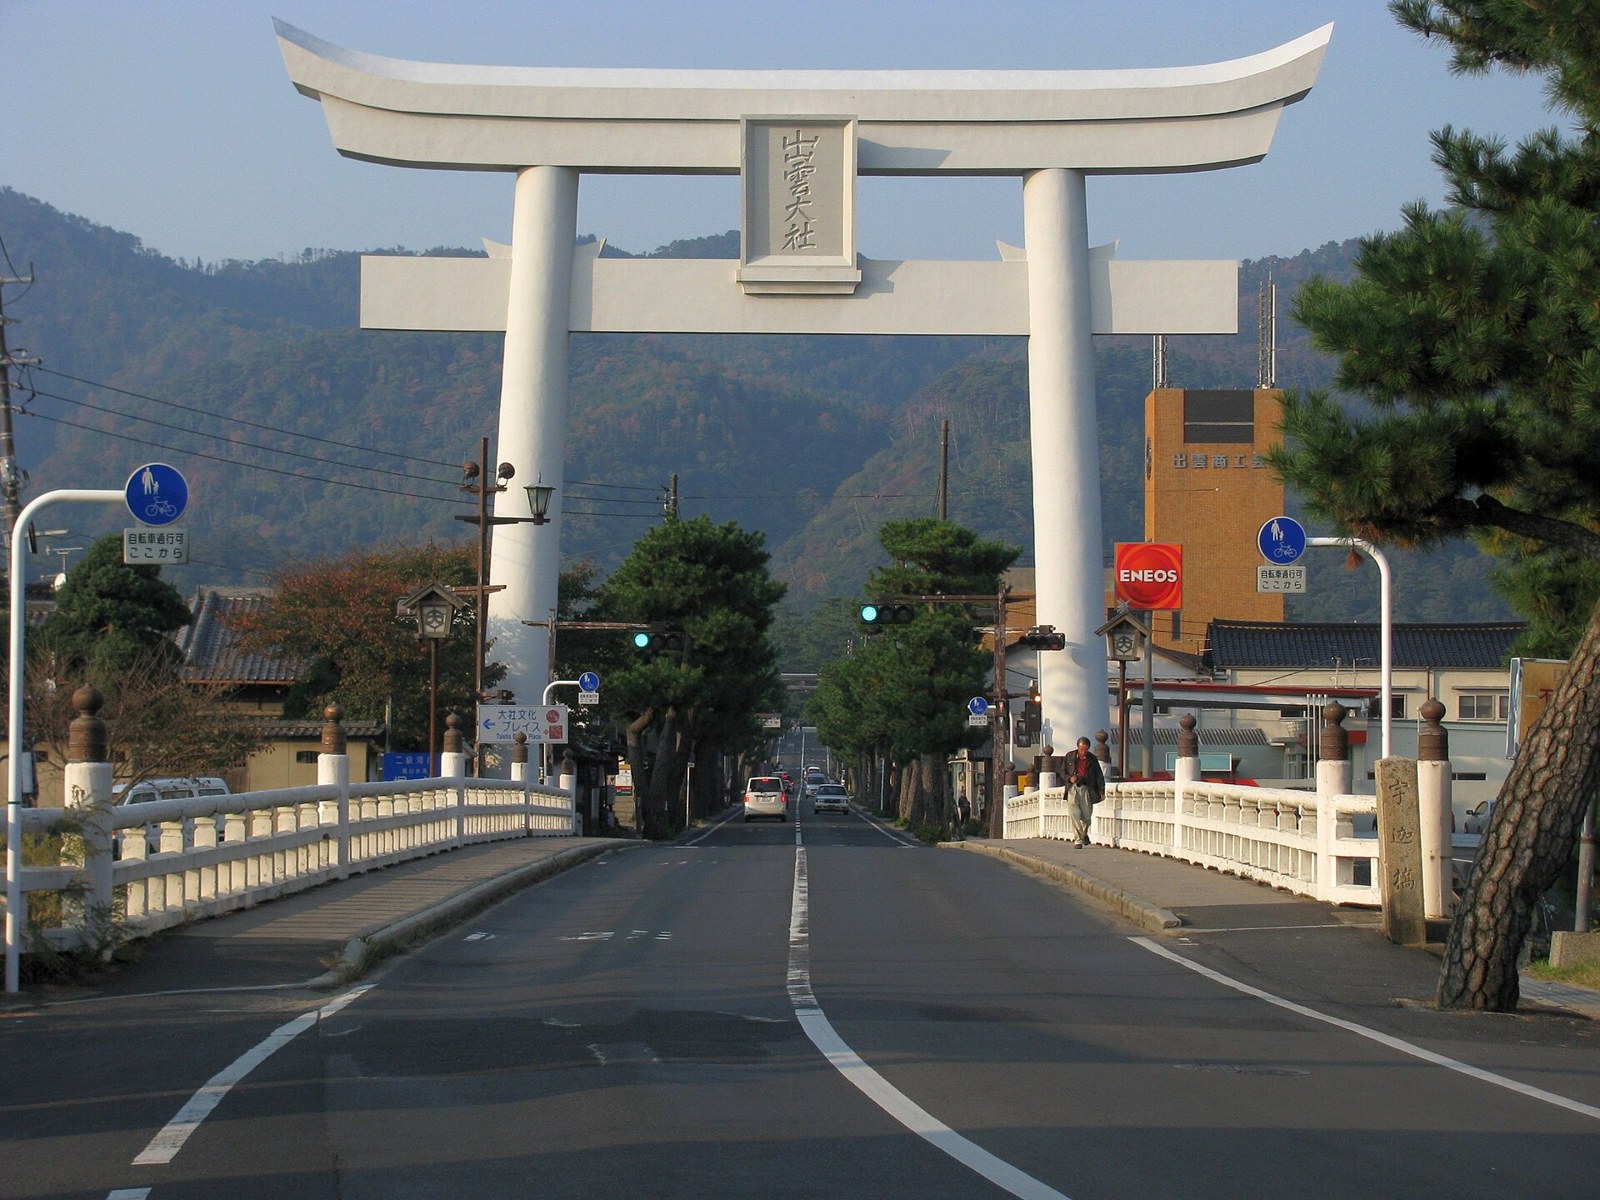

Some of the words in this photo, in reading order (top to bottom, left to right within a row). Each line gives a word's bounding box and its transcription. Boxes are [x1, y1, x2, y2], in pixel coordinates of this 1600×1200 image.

[781, 129, 820, 251] 出雲大社
[128, 532, 184, 545] 自転車通行可
[129, 547, 183, 558] ここから
[1119, 569, 1178, 583] ENEOS
[1261, 569, 1303, 579] 自転車通行可
[1262, 580, 1302, 590] ここから
[497, 709, 537, 721] 大社文化
[503, 721, 541, 732] プレイス
